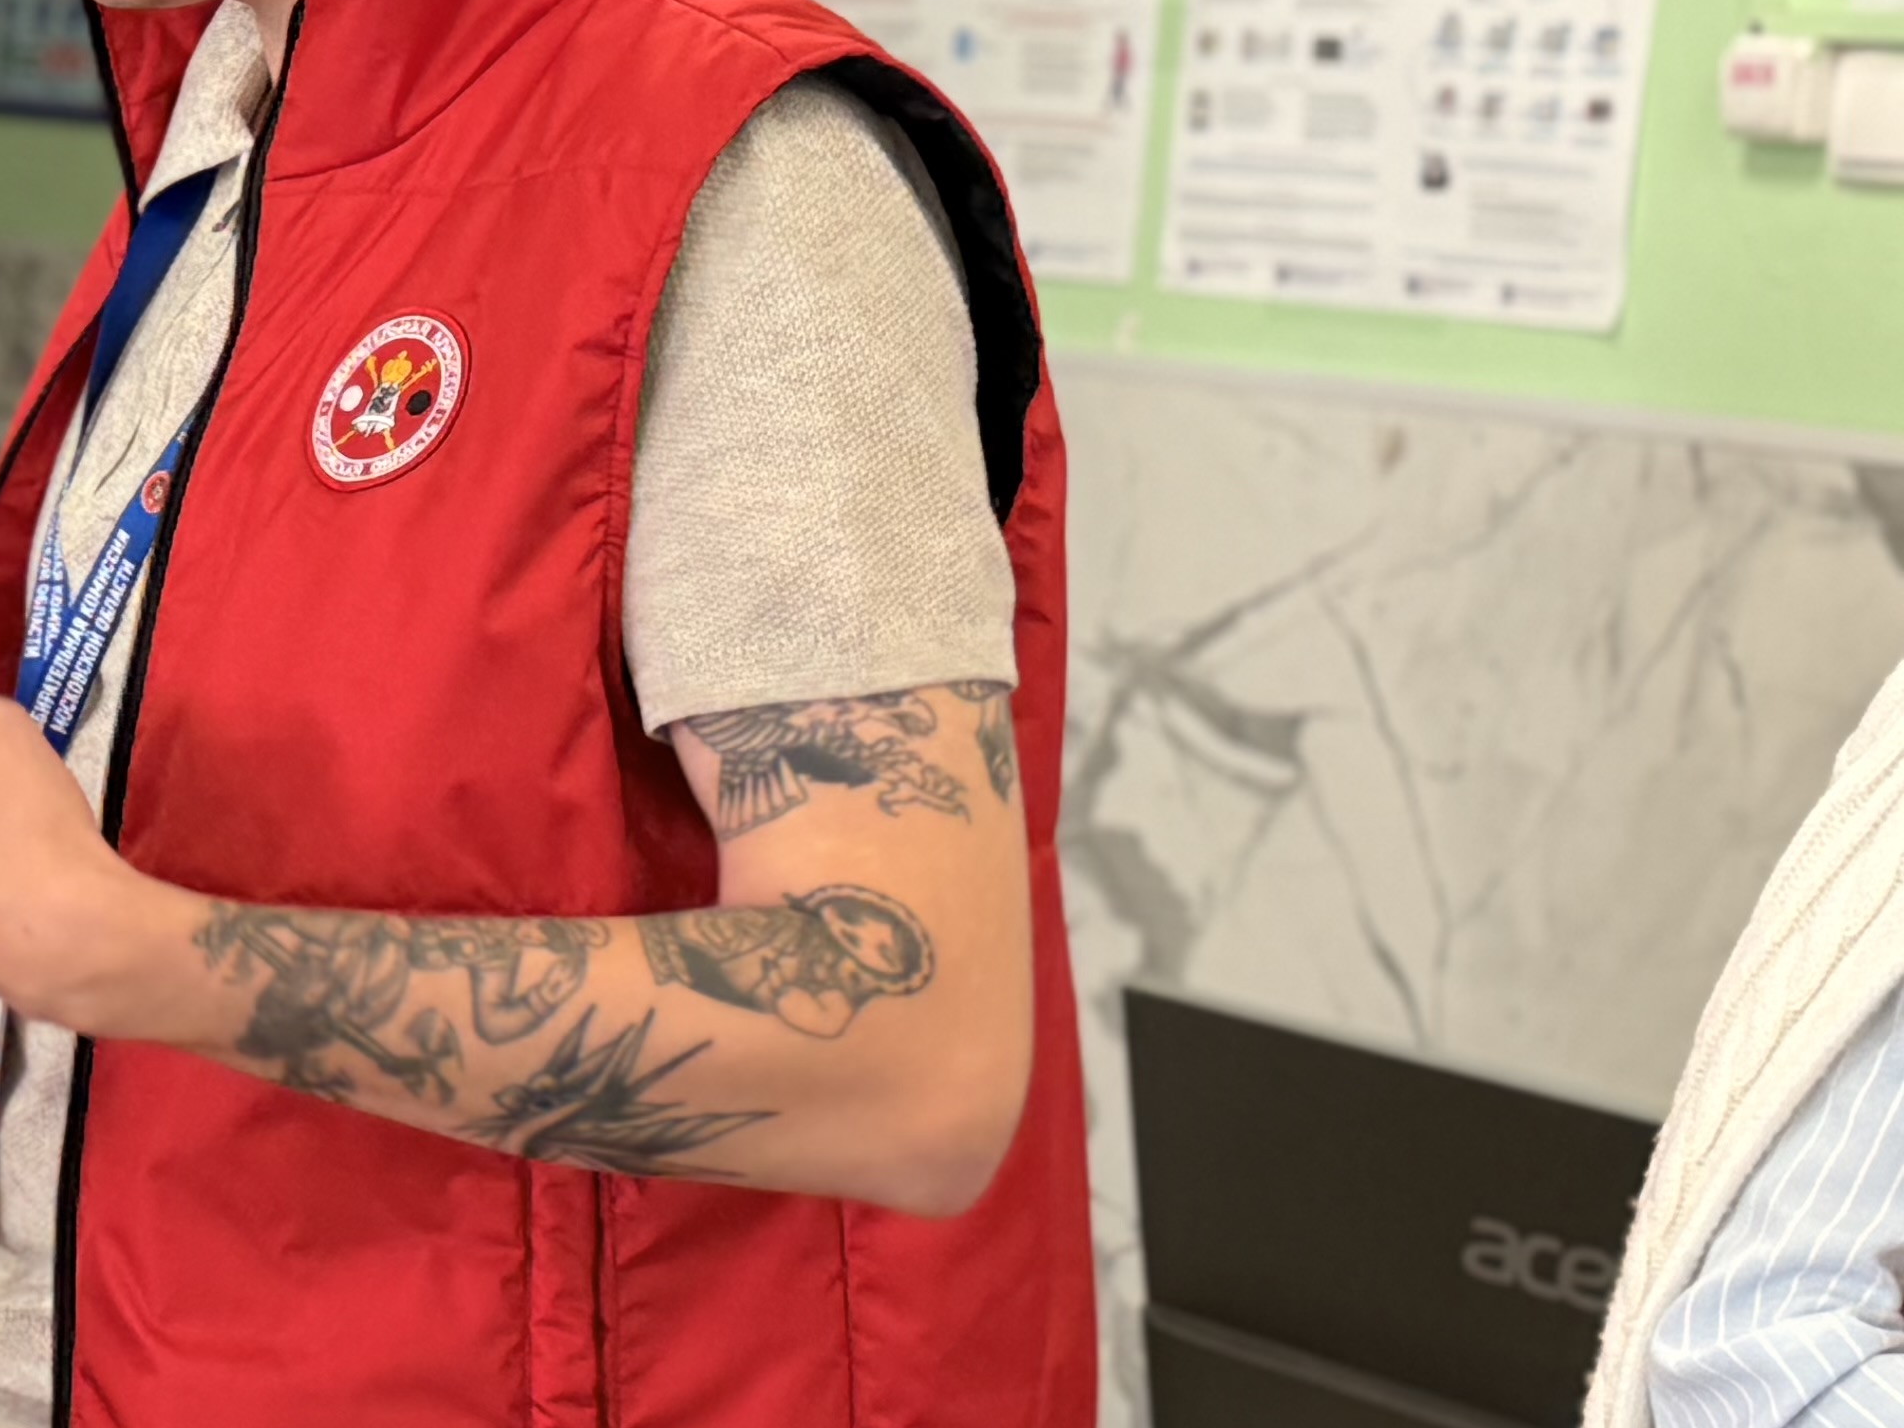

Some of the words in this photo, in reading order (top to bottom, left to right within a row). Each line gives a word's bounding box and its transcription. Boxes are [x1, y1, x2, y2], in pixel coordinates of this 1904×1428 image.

[30, 617, 90, 724] БИРАТЕЛЬНАЯ
[82, 528, 130, 618] КОМИССИЯ
[49, 632, 105, 735] МОСКОВСКОЙ
[96, 558, 135, 634] ОБЛАСТИ
[1462, 1217, 1623, 1314] ace
